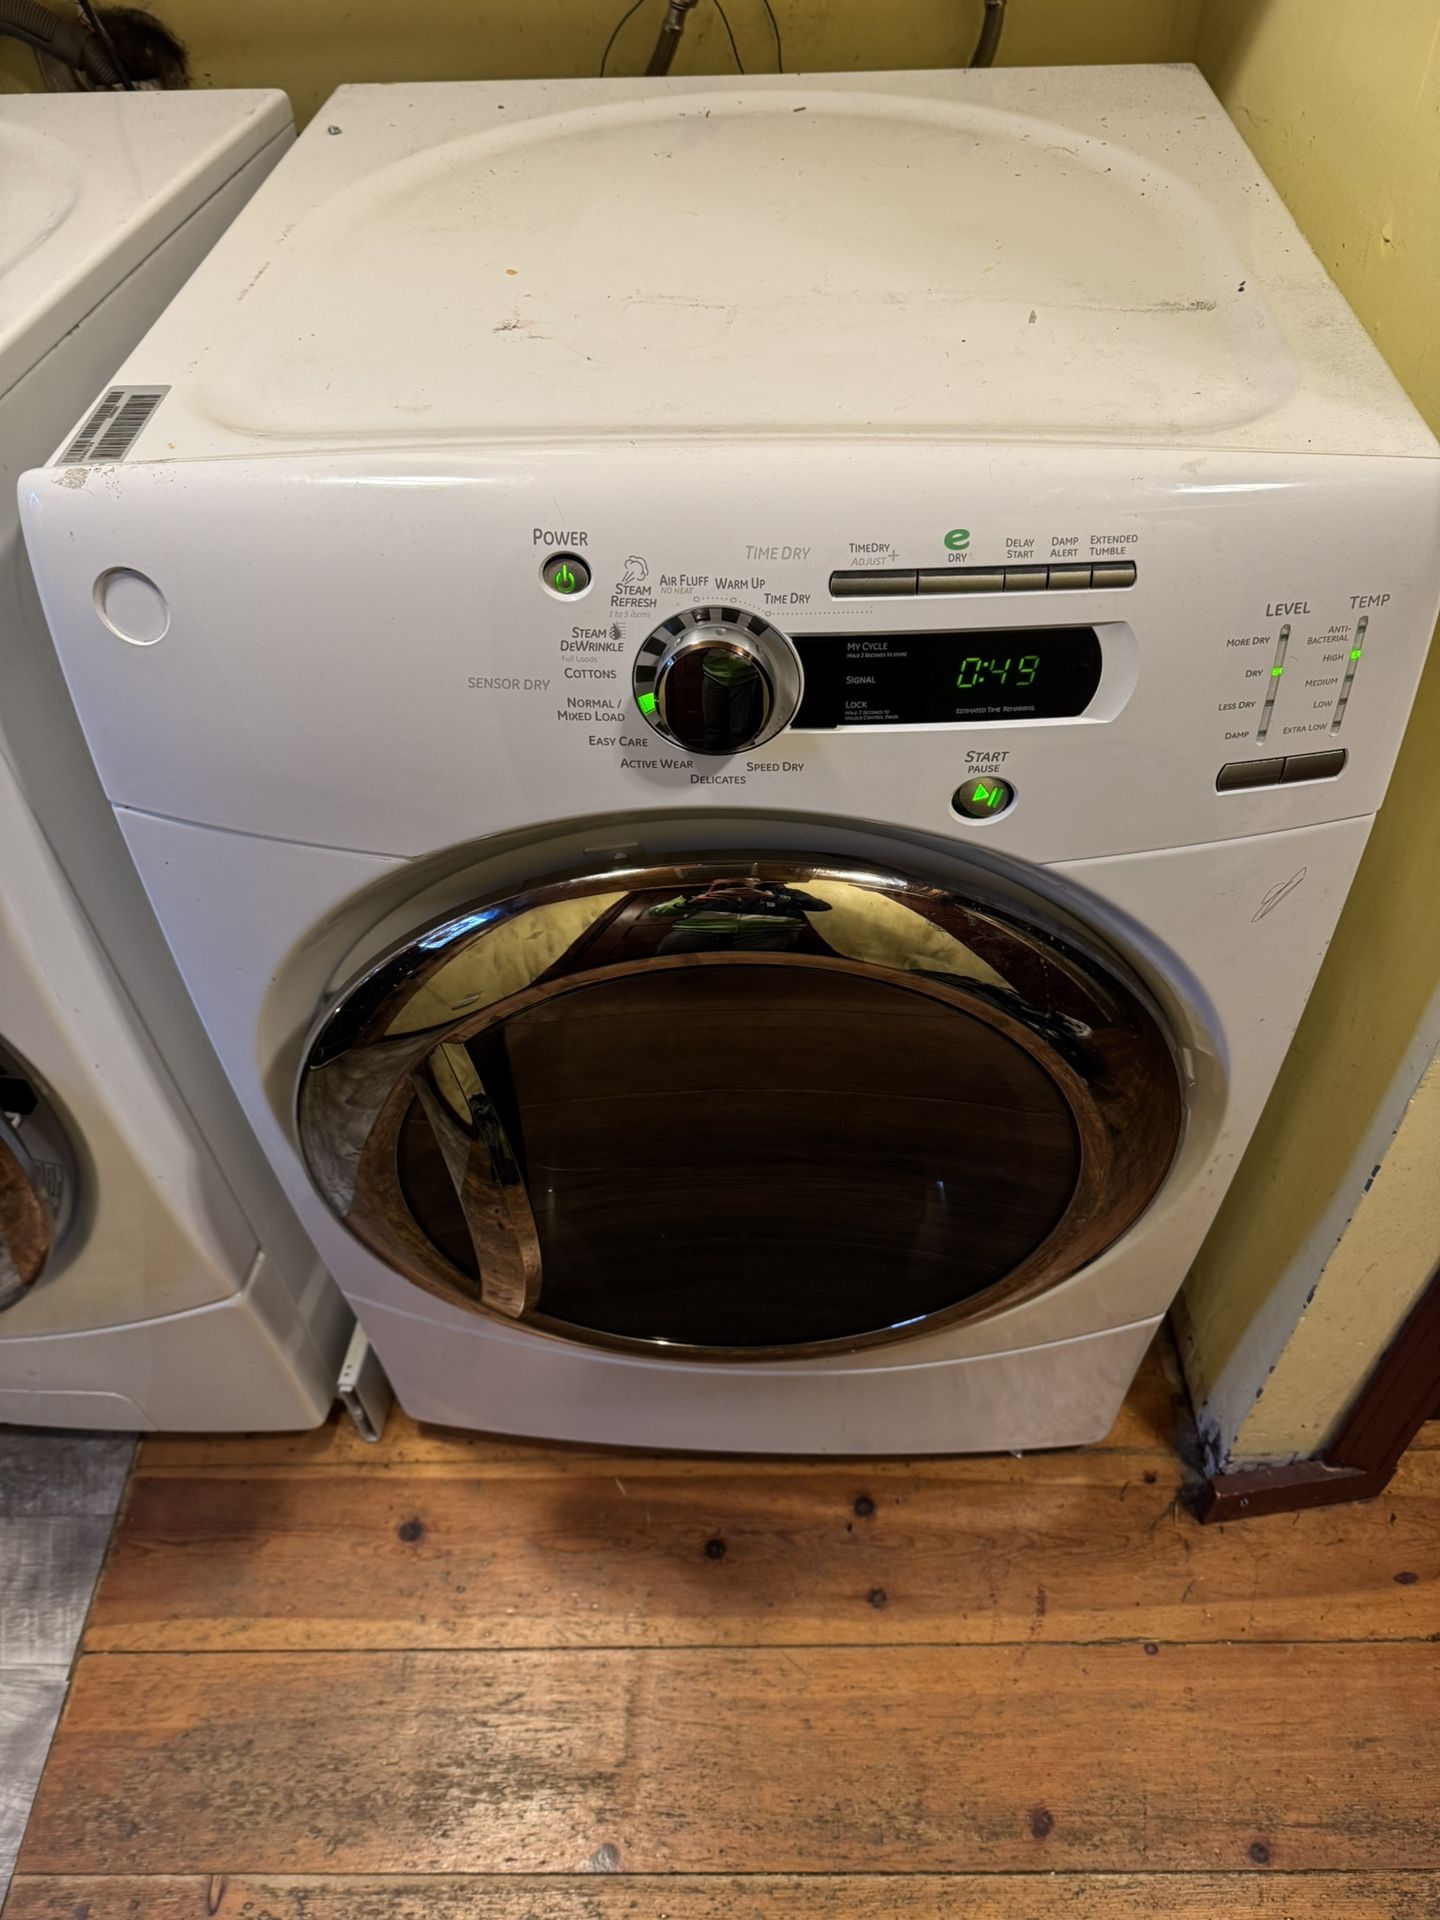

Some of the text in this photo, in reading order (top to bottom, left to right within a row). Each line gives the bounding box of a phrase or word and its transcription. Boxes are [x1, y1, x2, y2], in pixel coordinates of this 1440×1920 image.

[533, 528, 588, 546] POWER
[1052, 537, 1079, 546] DAMP
[1090, 534, 1138, 544] EXTENDED
[1006, 538, 1034, 547] DELAY
[746, 545, 812, 560] TIME DRY
[1007, 550, 1034, 558] START
[1050, 549, 1078, 557] ALERT
[1089, 547, 1126, 556] TUMBLE
[851, 557, 886, 566] ADJUST
[948, 553, 967, 563] DRY
[660, 574, 709, 586] AIR FLUFF
[715, 577, 766, 589] WARM UP
[615, 583, 652, 595] STEAM
[611, 595, 657, 608] REFRESH
[764, 592, 811, 604] TIME DRY
[1350, 594, 1391, 610] TEMP
[1266, 602, 1310, 617] LEVEL
[572, 627, 606, 638] STEAM
[1328, 625, 1351, 633] ANTI-
[1227, 637, 1270, 647] MORE DRY
[1307, 635, 1349, 645] BACTERIAL
[847, 642, 888, 651] MY CYCLE
[576, 655, 598, 663] Loads
[1323, 654, 1344, 662] HIGH
[564, 667, 616, 679] COTTONS
[957, 656, 1040, 688] 0:49
[1245, 670, 1263, 678] DRY
[468, 677, 550, 691] SENSOR DRY
[846, 676, 876, 684] SIGNAL
[1305, 678, 1338, 687] MEDIUM
[567, 697, 614, 709] NORMAL
[1218, 701, 1256, 711] LESS DRY
[1313, 700, 1333, 708] LOW
[557, 710, 625, 722] MIXED LOAD
[1283, 723, 1327, 734] EXTRA LOW
[1225, 731, 1249, 740] DAMP
[589, 735, 648, 747] EASY CARE
[964, 751, 1010, 763] START
[620, 758, 694, 769] ACTIVE WEAR
[747, 761, 804, 772] SPEED DRY
[968, 765, 1000, 773] PAUSE
[690, 774, 746, 784] DELICATES
